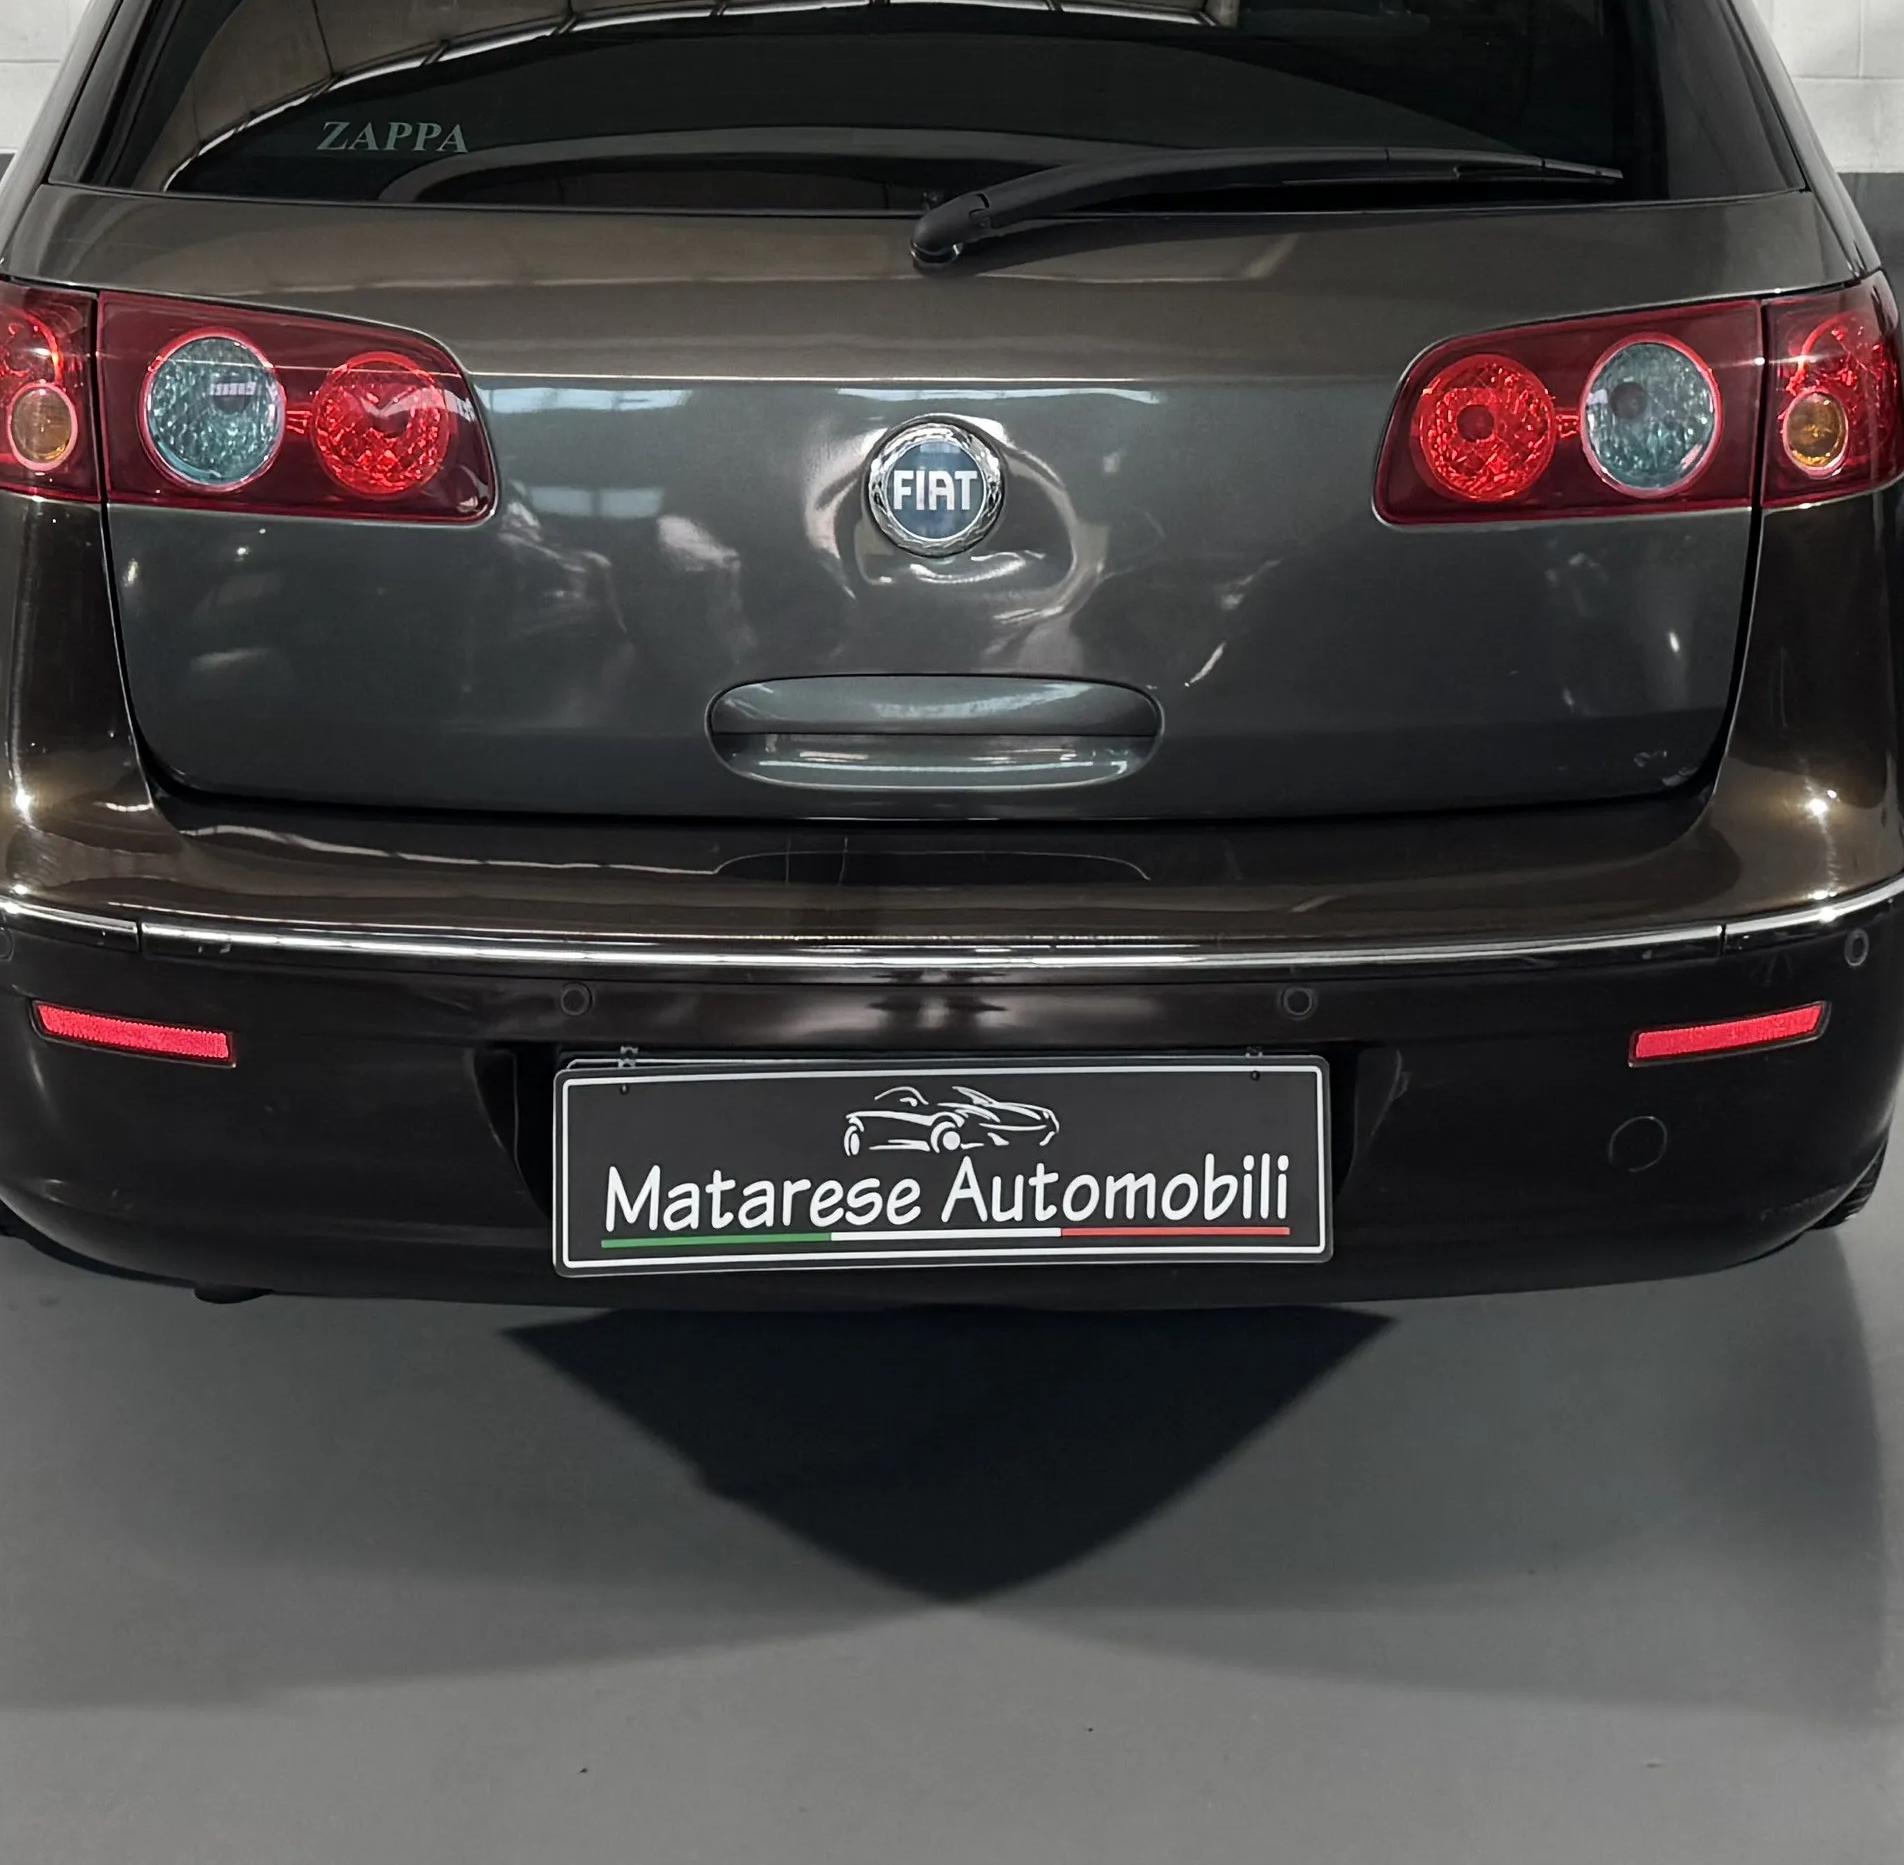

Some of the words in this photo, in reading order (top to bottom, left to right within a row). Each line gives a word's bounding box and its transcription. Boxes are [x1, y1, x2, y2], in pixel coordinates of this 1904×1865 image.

[316, 121, 469, 154] ZAPPA
[892, 469, 978, 511] FIAT
[604, 1163, 923, 1234] Matarese
[939, 1151, 1291, 1224] Automobili
